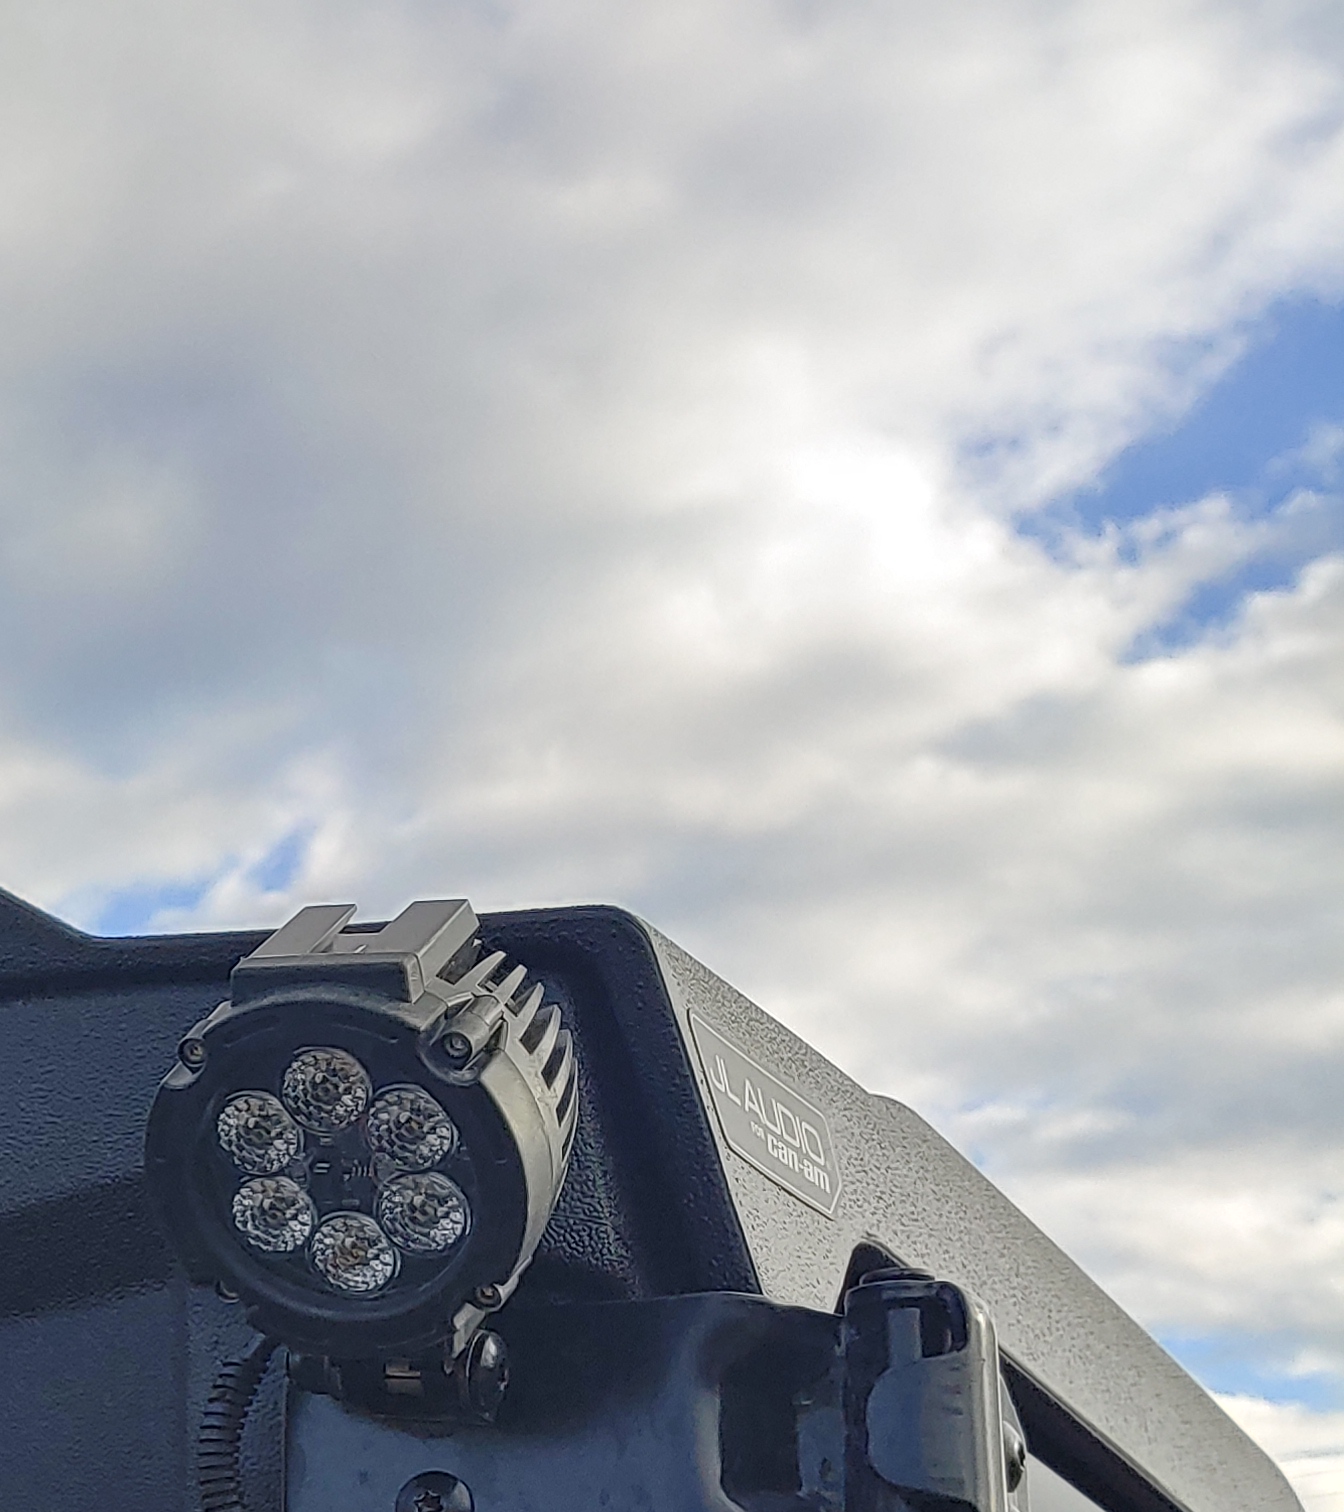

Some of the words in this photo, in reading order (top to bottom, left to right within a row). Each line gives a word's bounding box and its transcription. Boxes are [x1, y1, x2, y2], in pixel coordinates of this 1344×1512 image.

[709, 1054, 742, 1107] JL
[744, 1077, 826, 1166] AUDIO
[767, 1132, 831, 1194] can-am
